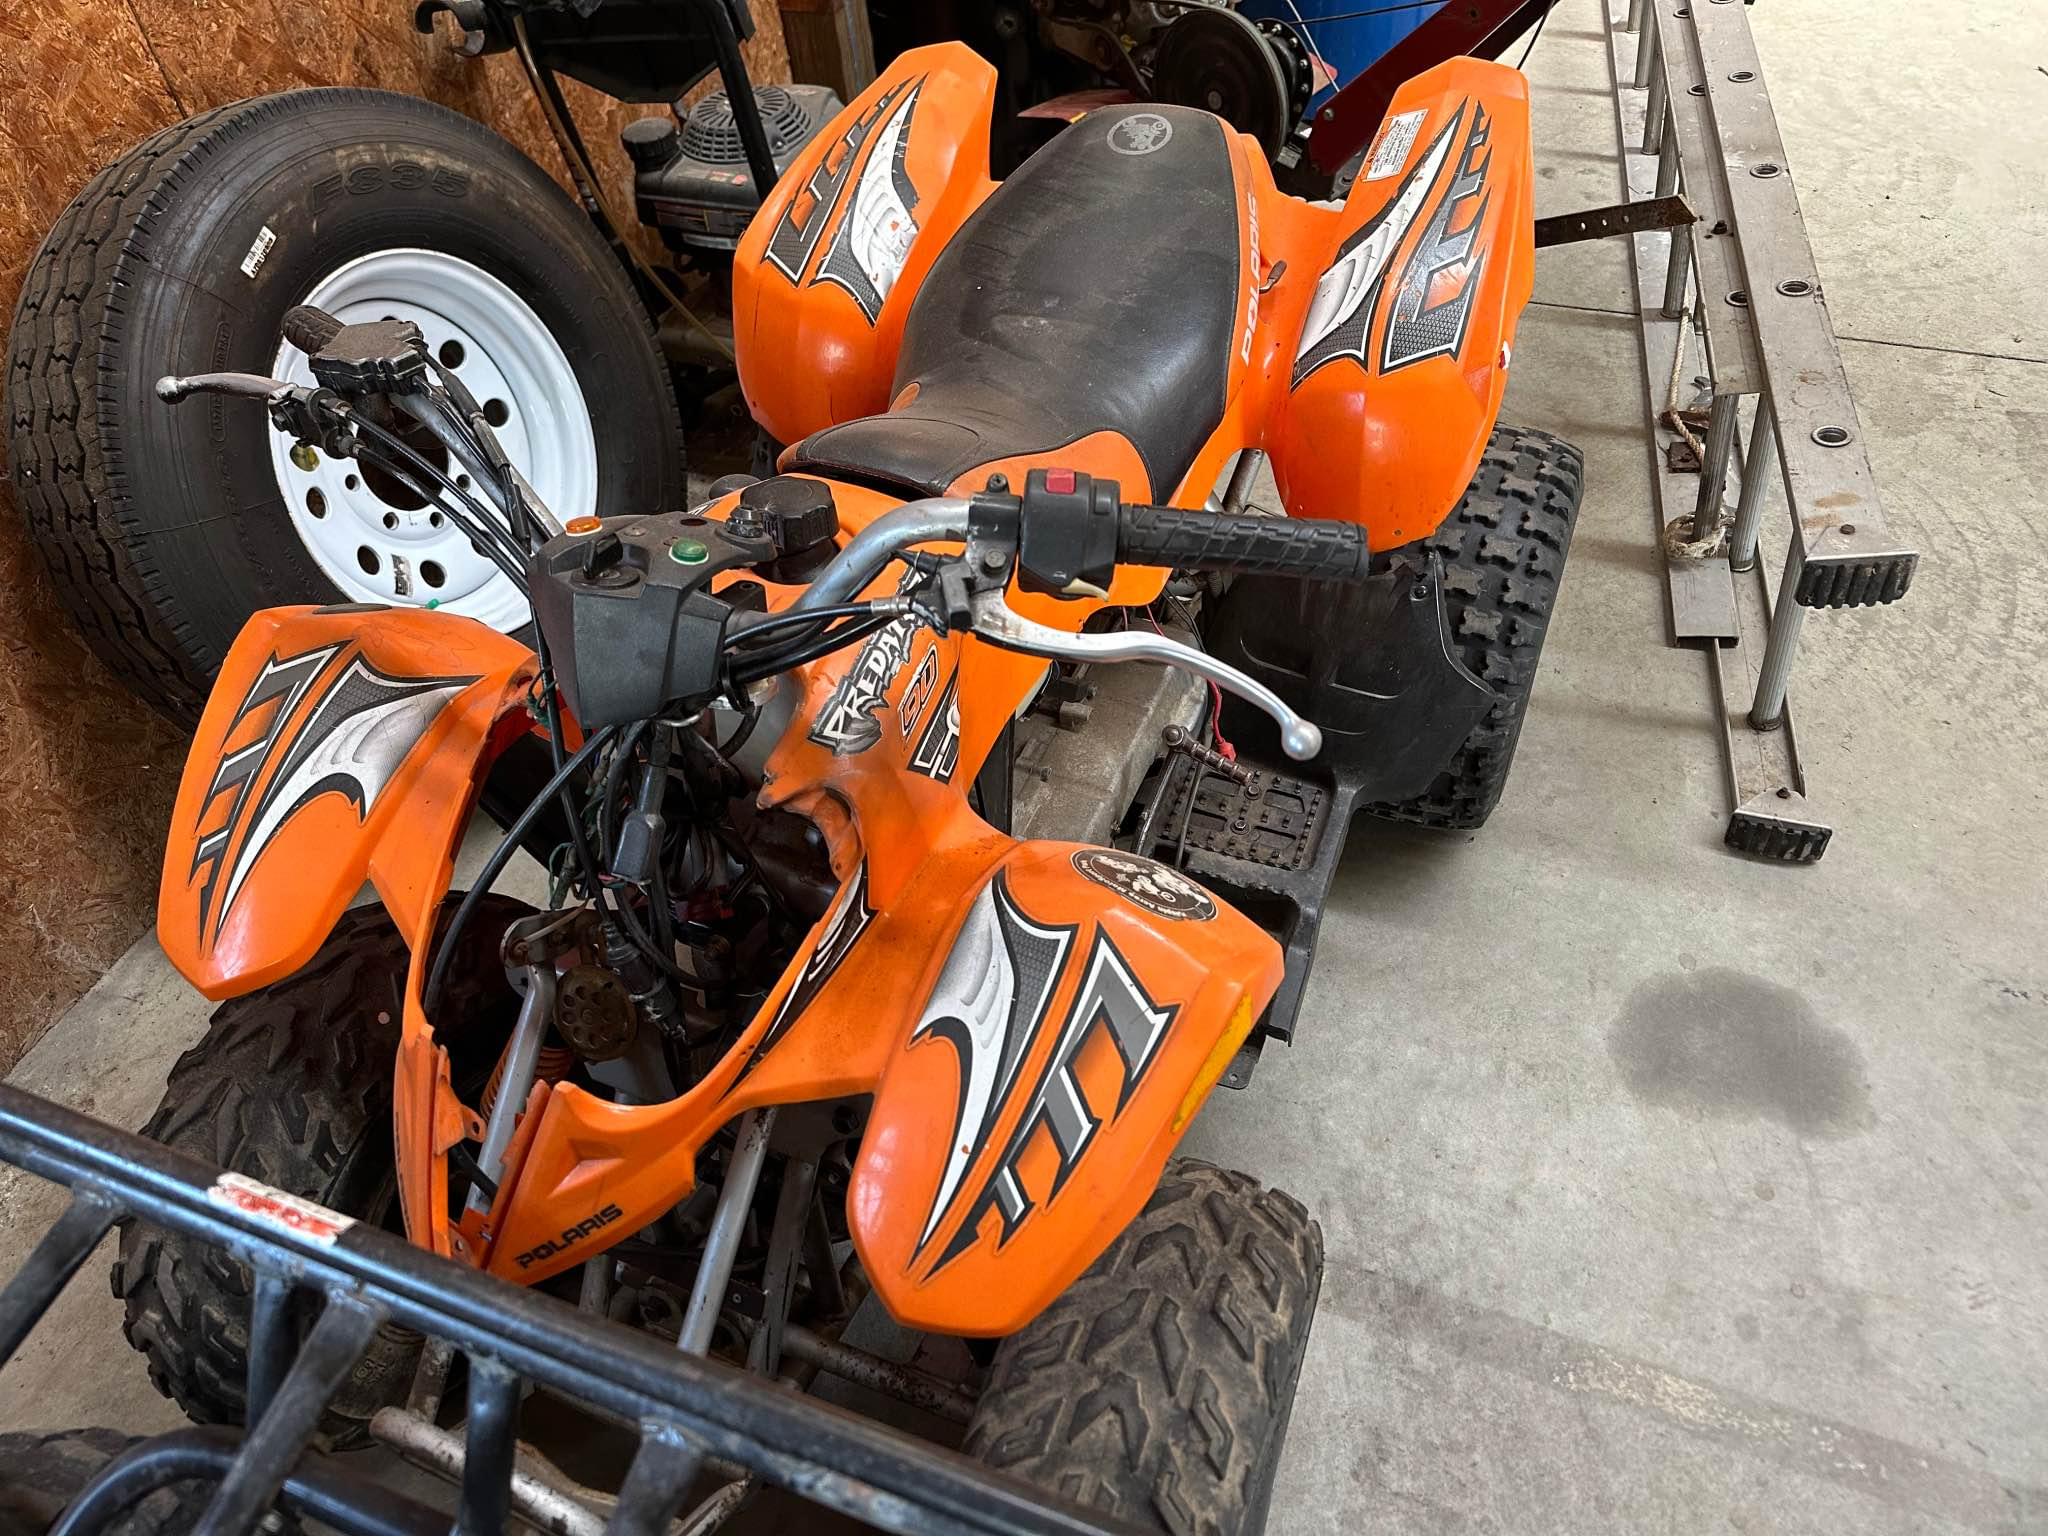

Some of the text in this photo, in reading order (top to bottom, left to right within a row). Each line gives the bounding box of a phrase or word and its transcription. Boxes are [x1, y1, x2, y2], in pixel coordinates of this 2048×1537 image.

[1240, 191, 1261, 367] POLARIS
[817, 563, 928, 748] PREDAT
[900, 641, 939, 738] 90
[515, 1203, 623, 1269] POLARIS
